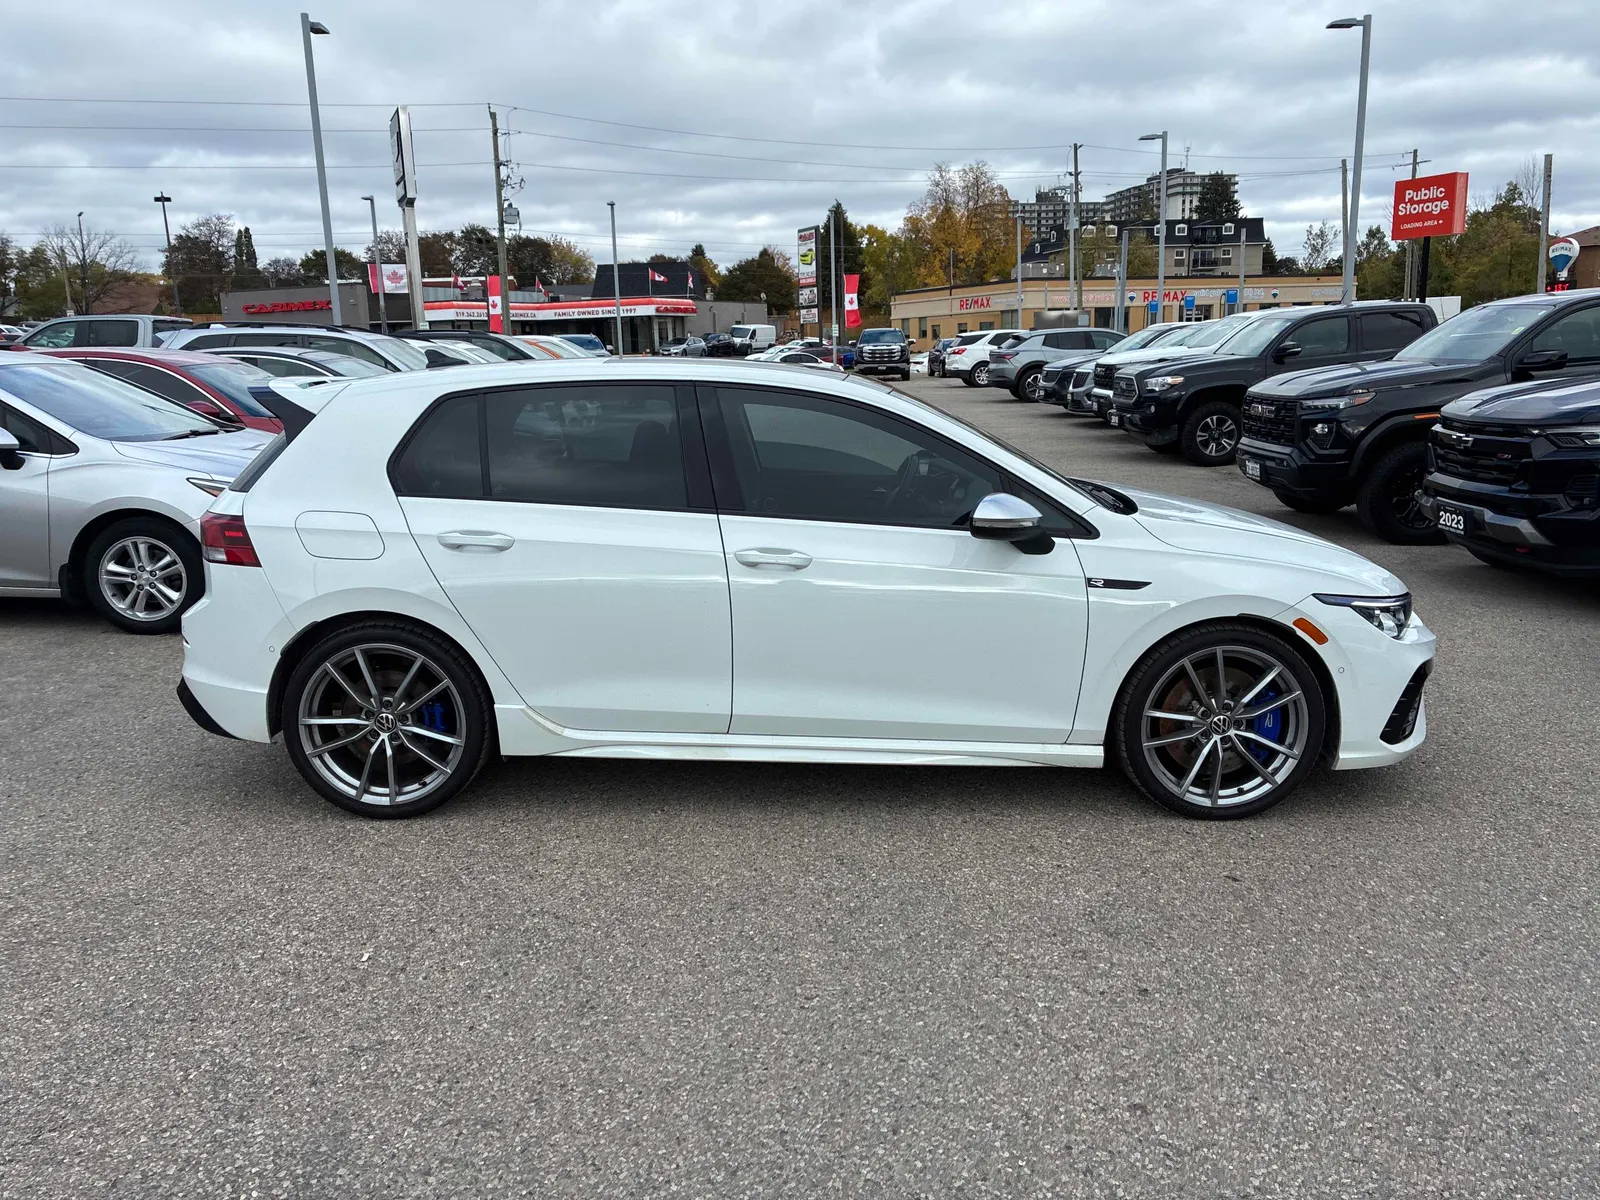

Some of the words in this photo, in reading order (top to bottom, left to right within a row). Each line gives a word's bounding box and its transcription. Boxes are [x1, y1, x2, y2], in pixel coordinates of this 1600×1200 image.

[1405, 186, 1446, 202] Public
[1398, 199, 1450, 216] Storage
[1400, 221, 1423, 230] LOADING
[1423, 219, 1438, 227] AREA
[1142, 290, 1187, 303] REMAX
[242, 299, 332, 314] CARIMEX
[959, 297, 991, 311] RE/MAX
[576, 309, 600, 317] OWNED
[601, 308, 616, 316] SINC
[1439, 510, 1464, 530] 2023
